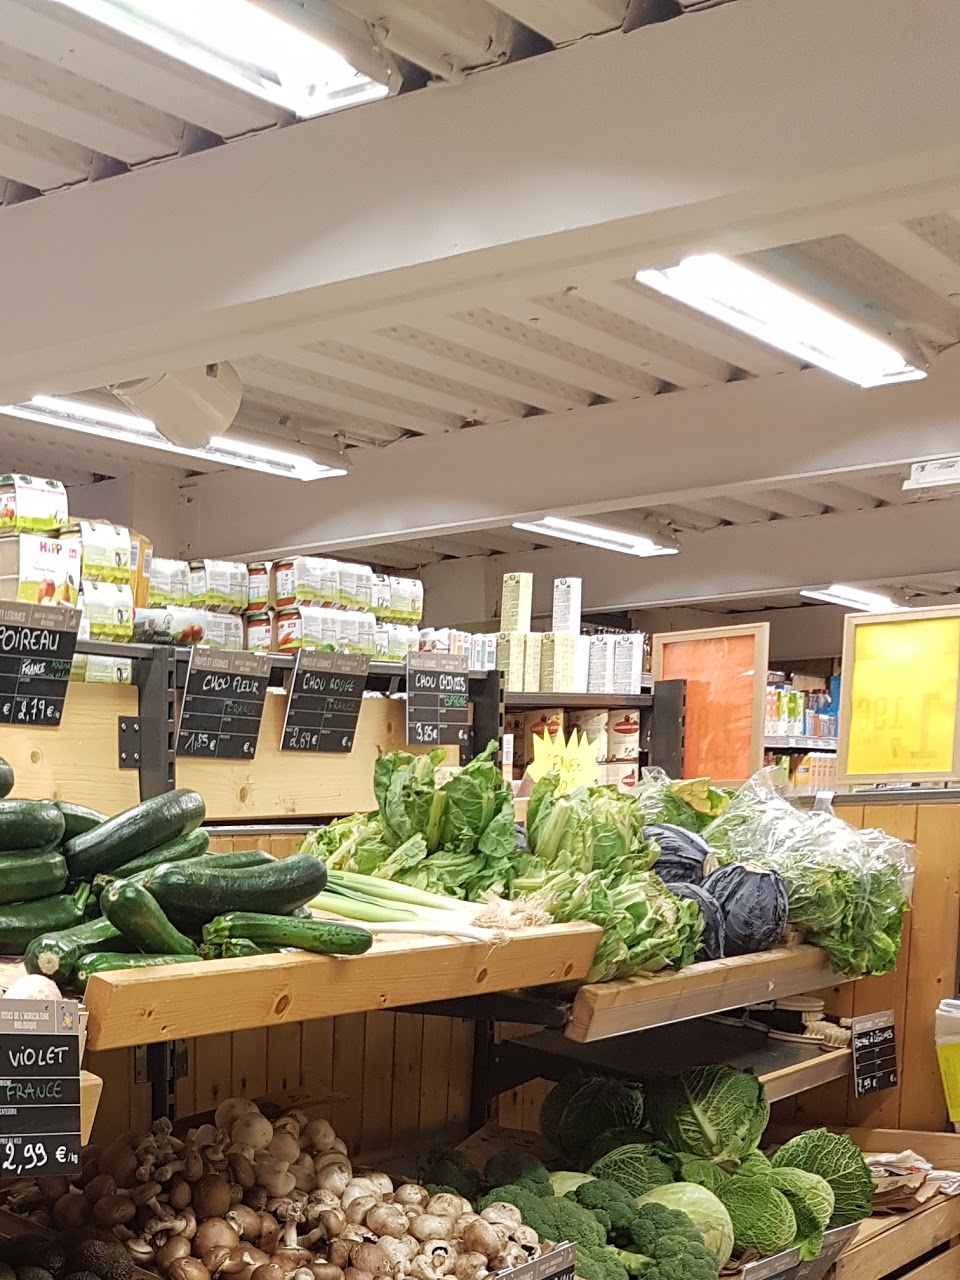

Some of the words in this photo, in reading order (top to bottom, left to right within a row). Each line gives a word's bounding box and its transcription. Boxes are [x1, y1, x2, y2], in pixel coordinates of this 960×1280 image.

[40, 541, 62, 555] HiPP
[22, 660, 46, 675] FRANCE
[203, 675, 230, 691] CHOU
[233, 676, 259, 695] FLEUR
[303, 673, 326, 690] CHOU
[416, 674, 436, 688] CHOU
[18, 698, 45, 721] 2,79
[290, 728, 311, 748] 2,69
[6, 1081, 62, 1101] FRANCE
[3, 1143, 47, 1174] 2,99
